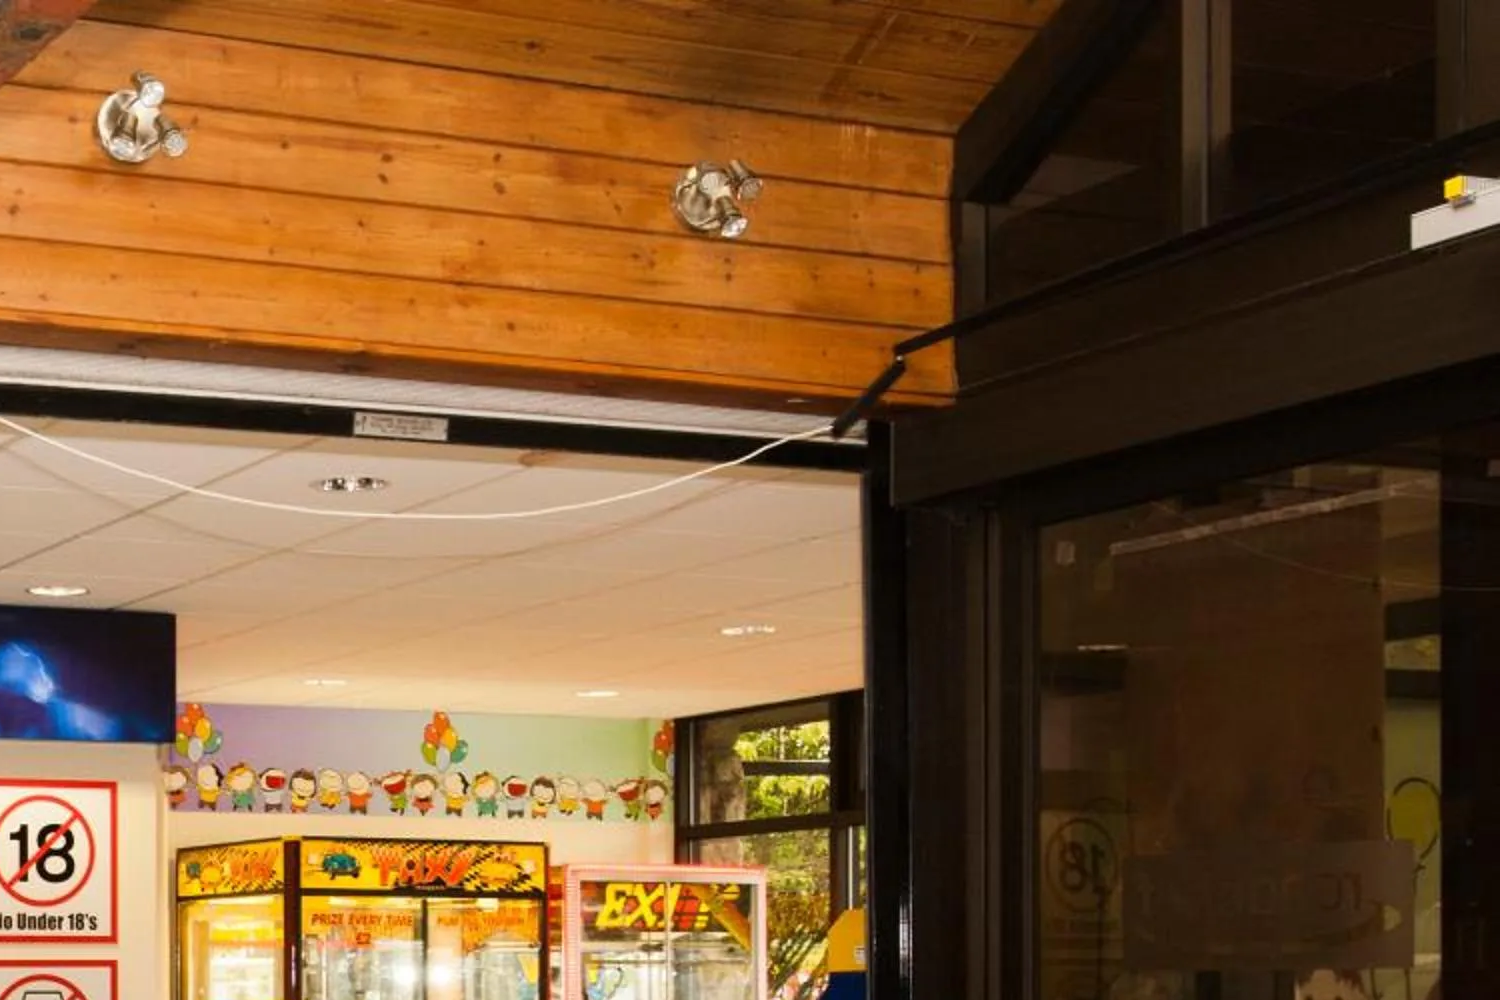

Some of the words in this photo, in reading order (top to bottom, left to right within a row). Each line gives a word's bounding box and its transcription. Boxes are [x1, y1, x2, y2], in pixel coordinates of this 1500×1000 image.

[10, 823, 75, 883] 18
[17, 913, 64, 930] Under
[68, 913, 97, 930] 18's
[311, 913, 344, 925] PRIZE
